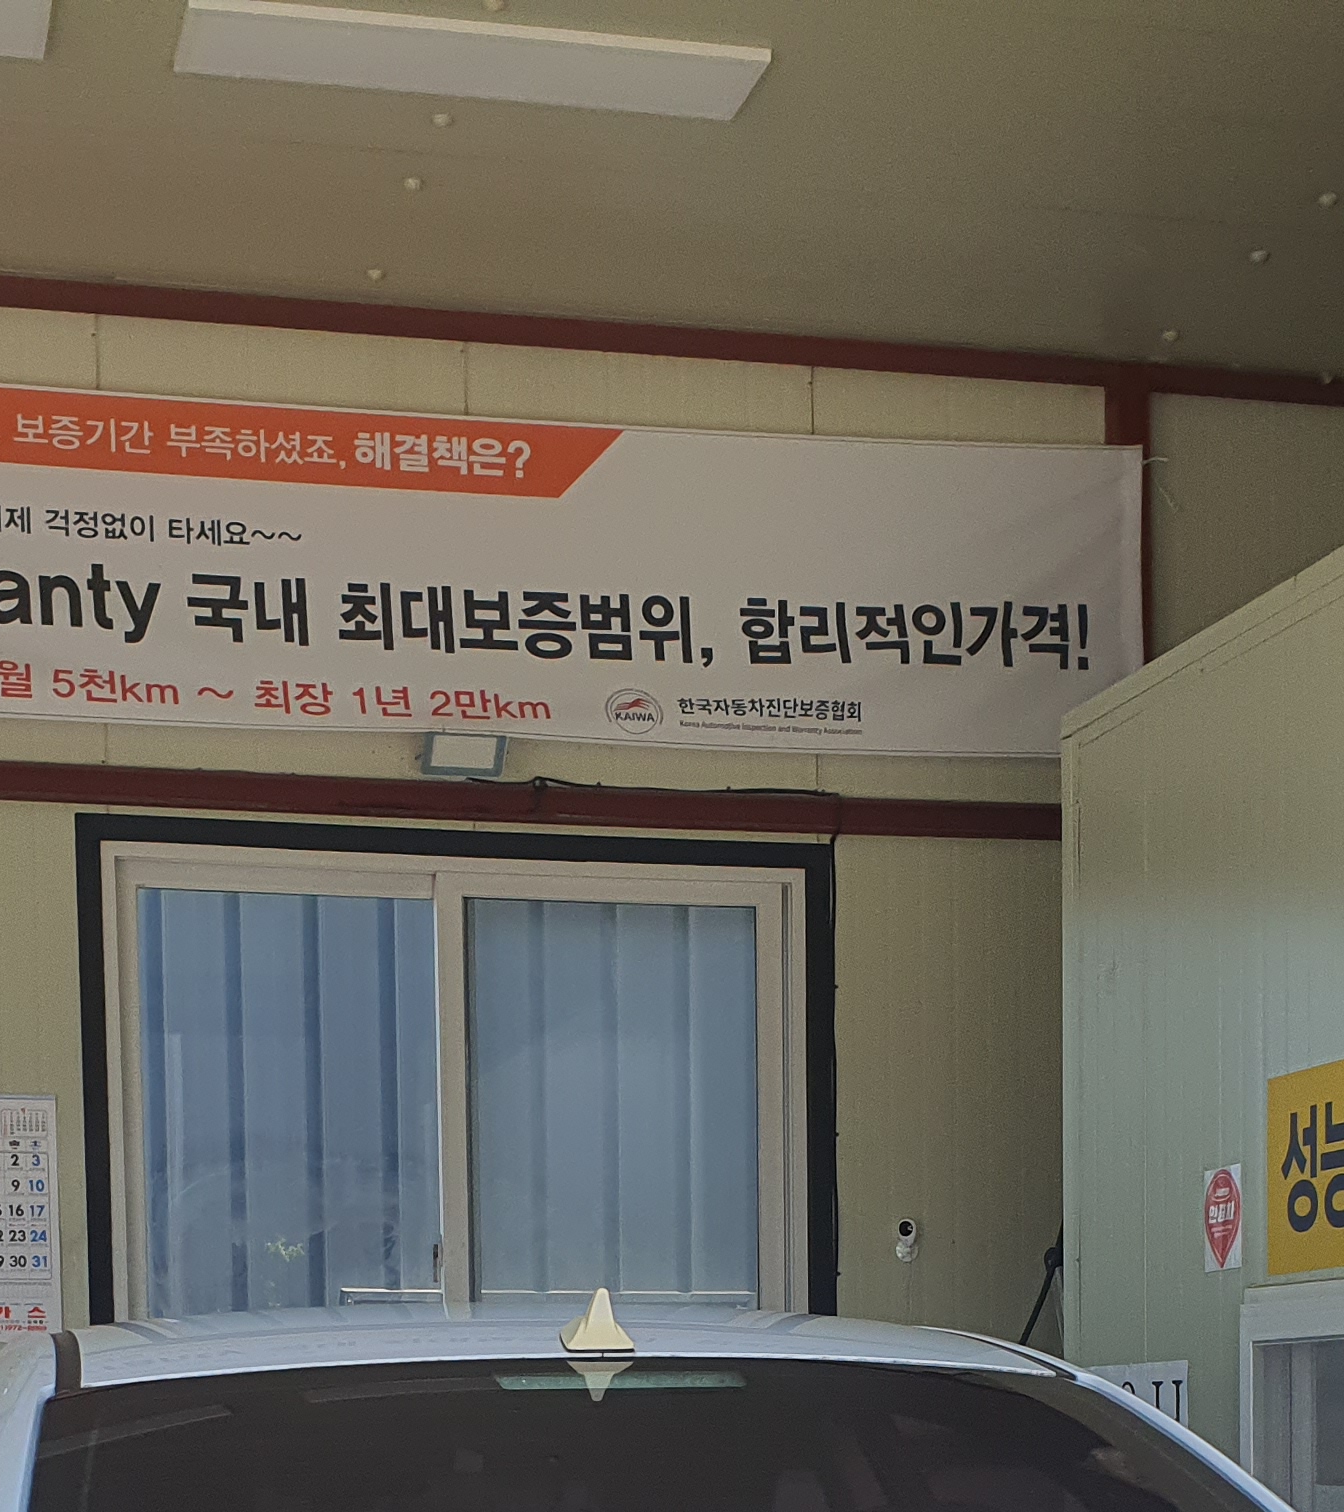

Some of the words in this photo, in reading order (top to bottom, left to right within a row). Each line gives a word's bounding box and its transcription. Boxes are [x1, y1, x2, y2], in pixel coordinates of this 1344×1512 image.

[13, 413, 154, 455] 보증기간
[166, 424, 346, 470] 부족하셨죠,
[354, 432, 531, 478] 해결책은?
[45, 509, 155, 542] 걱정없이
[187, 573, 309, 647] 국내
[339, 581, 713, 668] 최대보증범위,
[740, 598, 1089, 671] 합리적인가격!
[53, 667, 179, 705] 5천km
[254, 680, 333, 716] 최장
[352, 686, 413, 718] 1년
[430, 689, 552, 721] 2만km
[678, 698, 862, 722] 한국자동차진단보증협회
[615, 711, 655, 723] KAIWA
[11, 1155, 19, 1166] 2
[32, 1155, 40, 1166] 3
[12, 1180, 20, 1191] 9
[29, 1180, 44, 1192] 10
[9, 1205, 24, 1216] 16
[30, 1205, 45, 1217] 17
[9, 1231, 26, 1242] 23
[30, 1231, 47, 1242] 24
[10, 1256, 27, 1267] 30
[32, 1256, 48, 1268] 31
